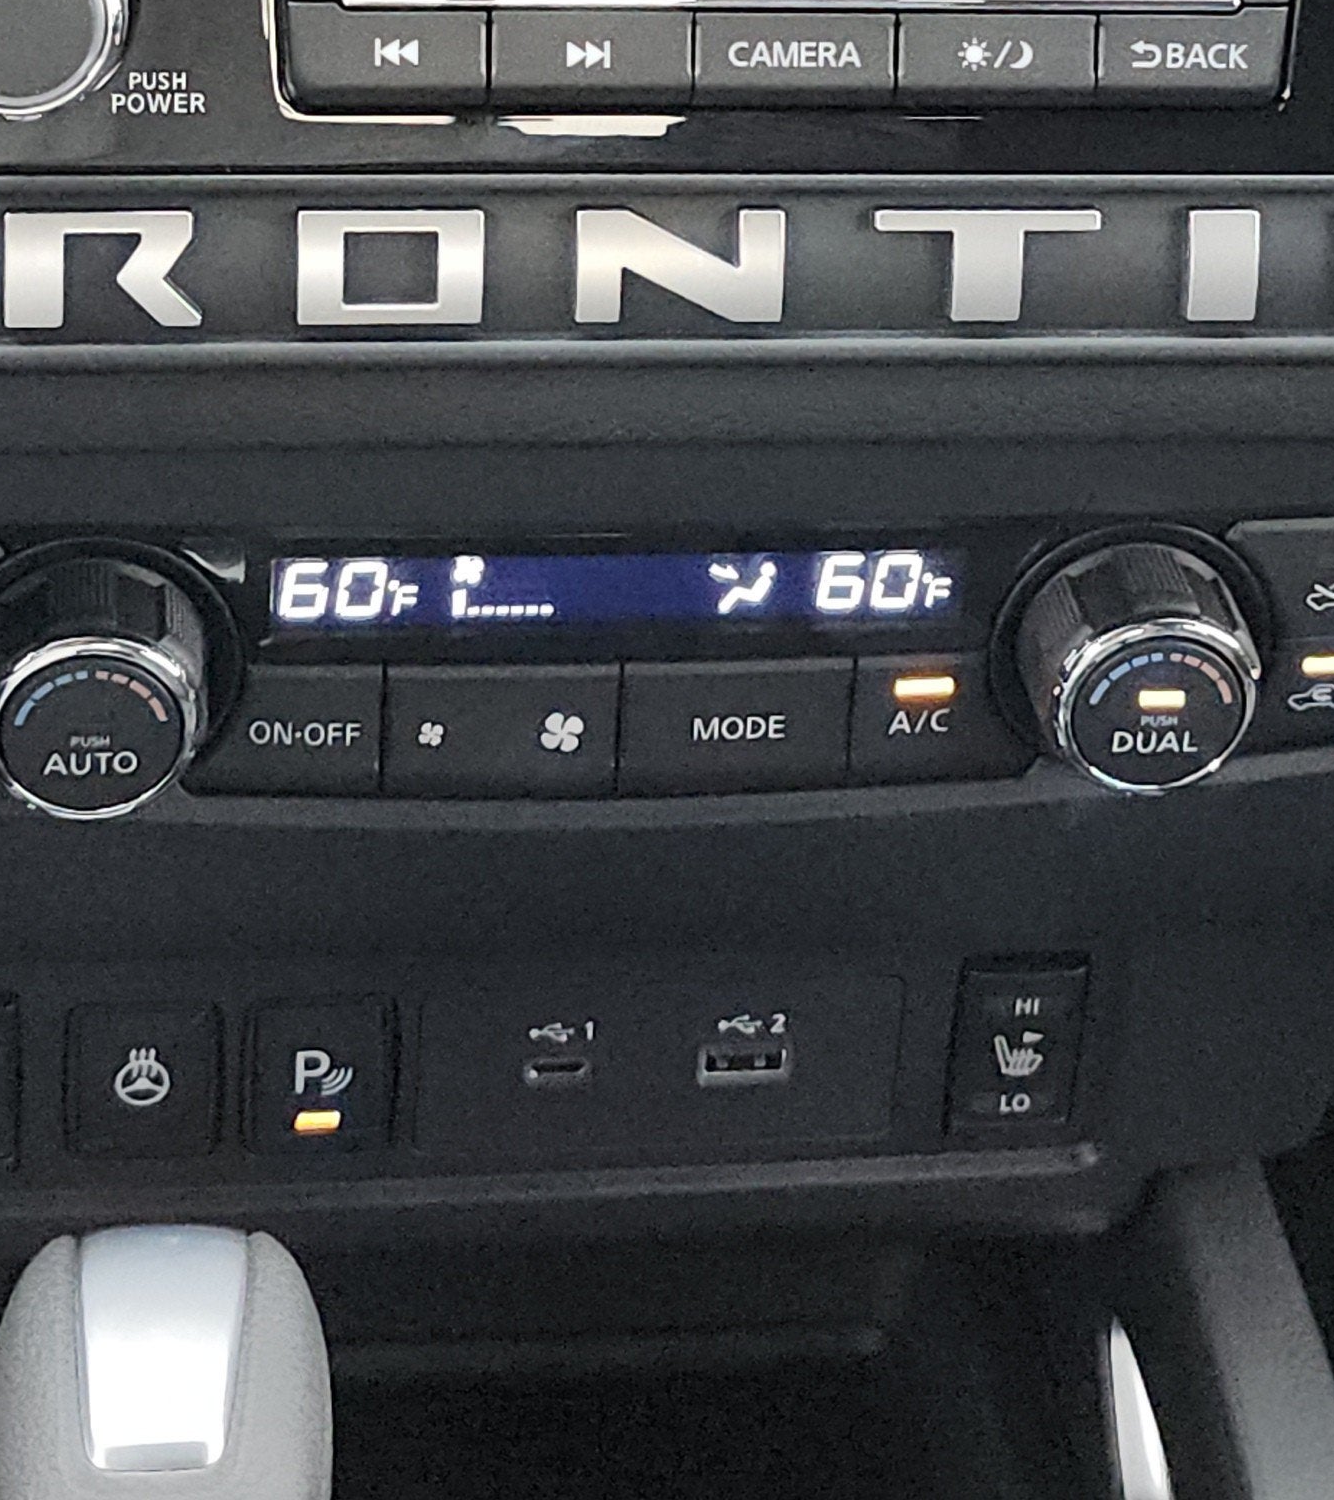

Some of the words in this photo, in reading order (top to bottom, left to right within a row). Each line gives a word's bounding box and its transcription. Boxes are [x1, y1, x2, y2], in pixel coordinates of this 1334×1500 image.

[729, 41, 863, 69] CAMERA
[1166, 43, 1249, 70] BACK
[129, 72, 188, 92] PUSH
[112, 93, 207, 115] POWER
[694, 716, 786, 742] MODE
[889, 709, 950, 736] A/C
[1141, 714, 1179, 727] PUSH
[70, 736, 112, 749] PUSH
[1112, 732, 1199, 755] DUAL
[44, 752, 139, 777] AUTO
[1016, 999, 1041, 1017] HI
[586, 1022, 595, 1042] 1
[771, 1014, 787, 1035] 2
[1000, 1094, 1032, 1114] LO
